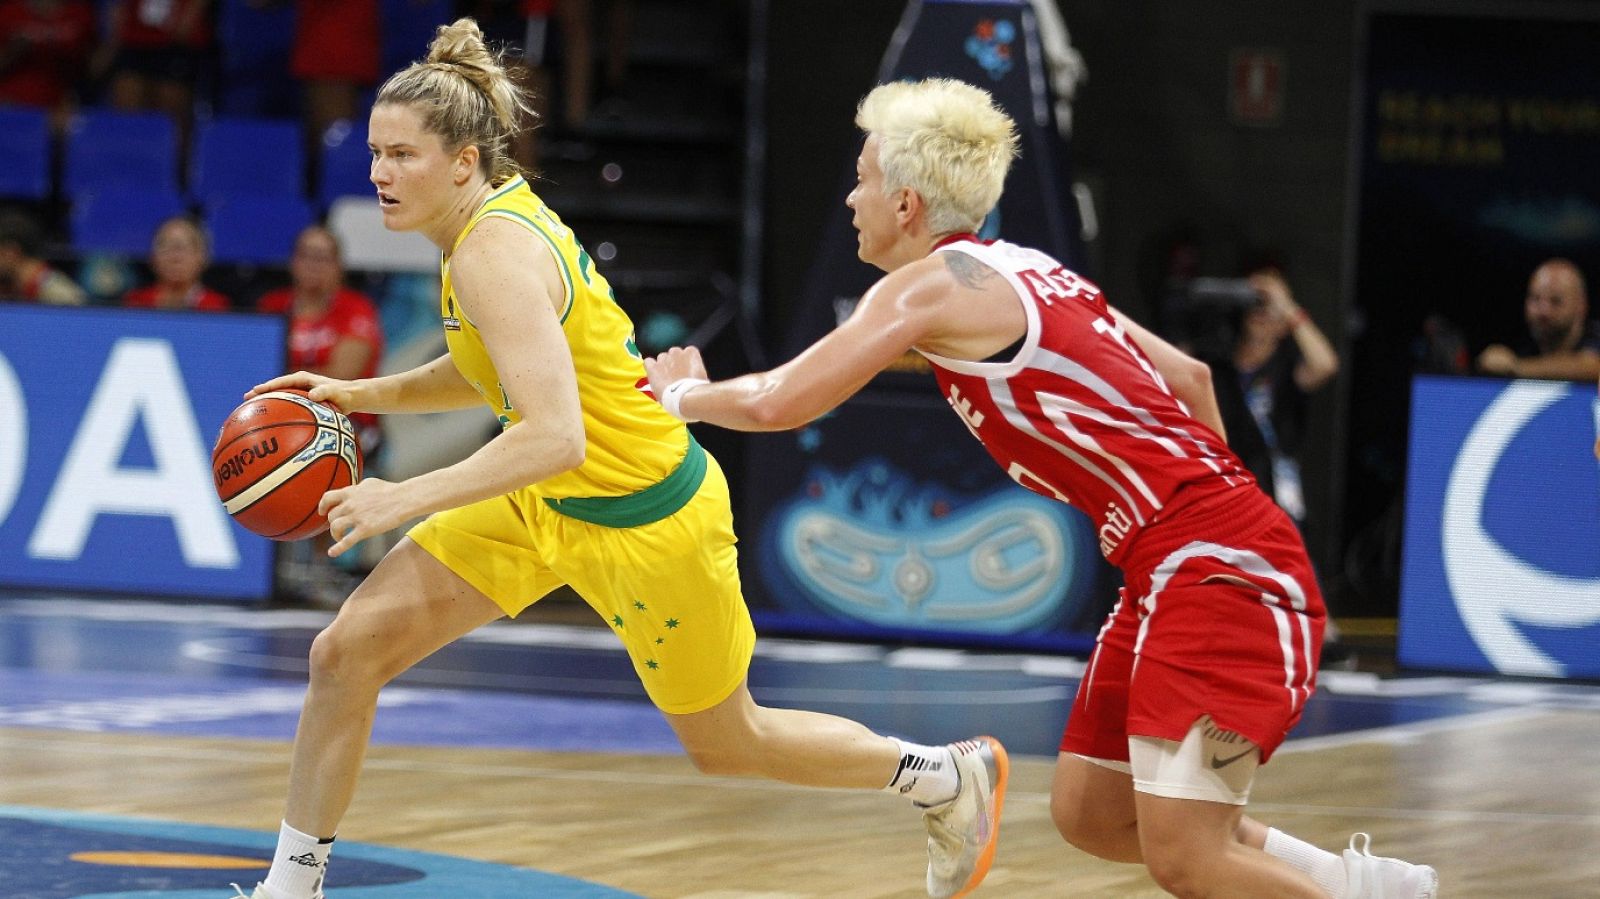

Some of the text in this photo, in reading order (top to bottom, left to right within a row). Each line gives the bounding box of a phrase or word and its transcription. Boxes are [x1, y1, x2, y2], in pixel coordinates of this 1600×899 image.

[214, 436, 279, 488] molten
[1100, 502, 1132, 557] anti
[288, 855, 322, 868] PEAK
